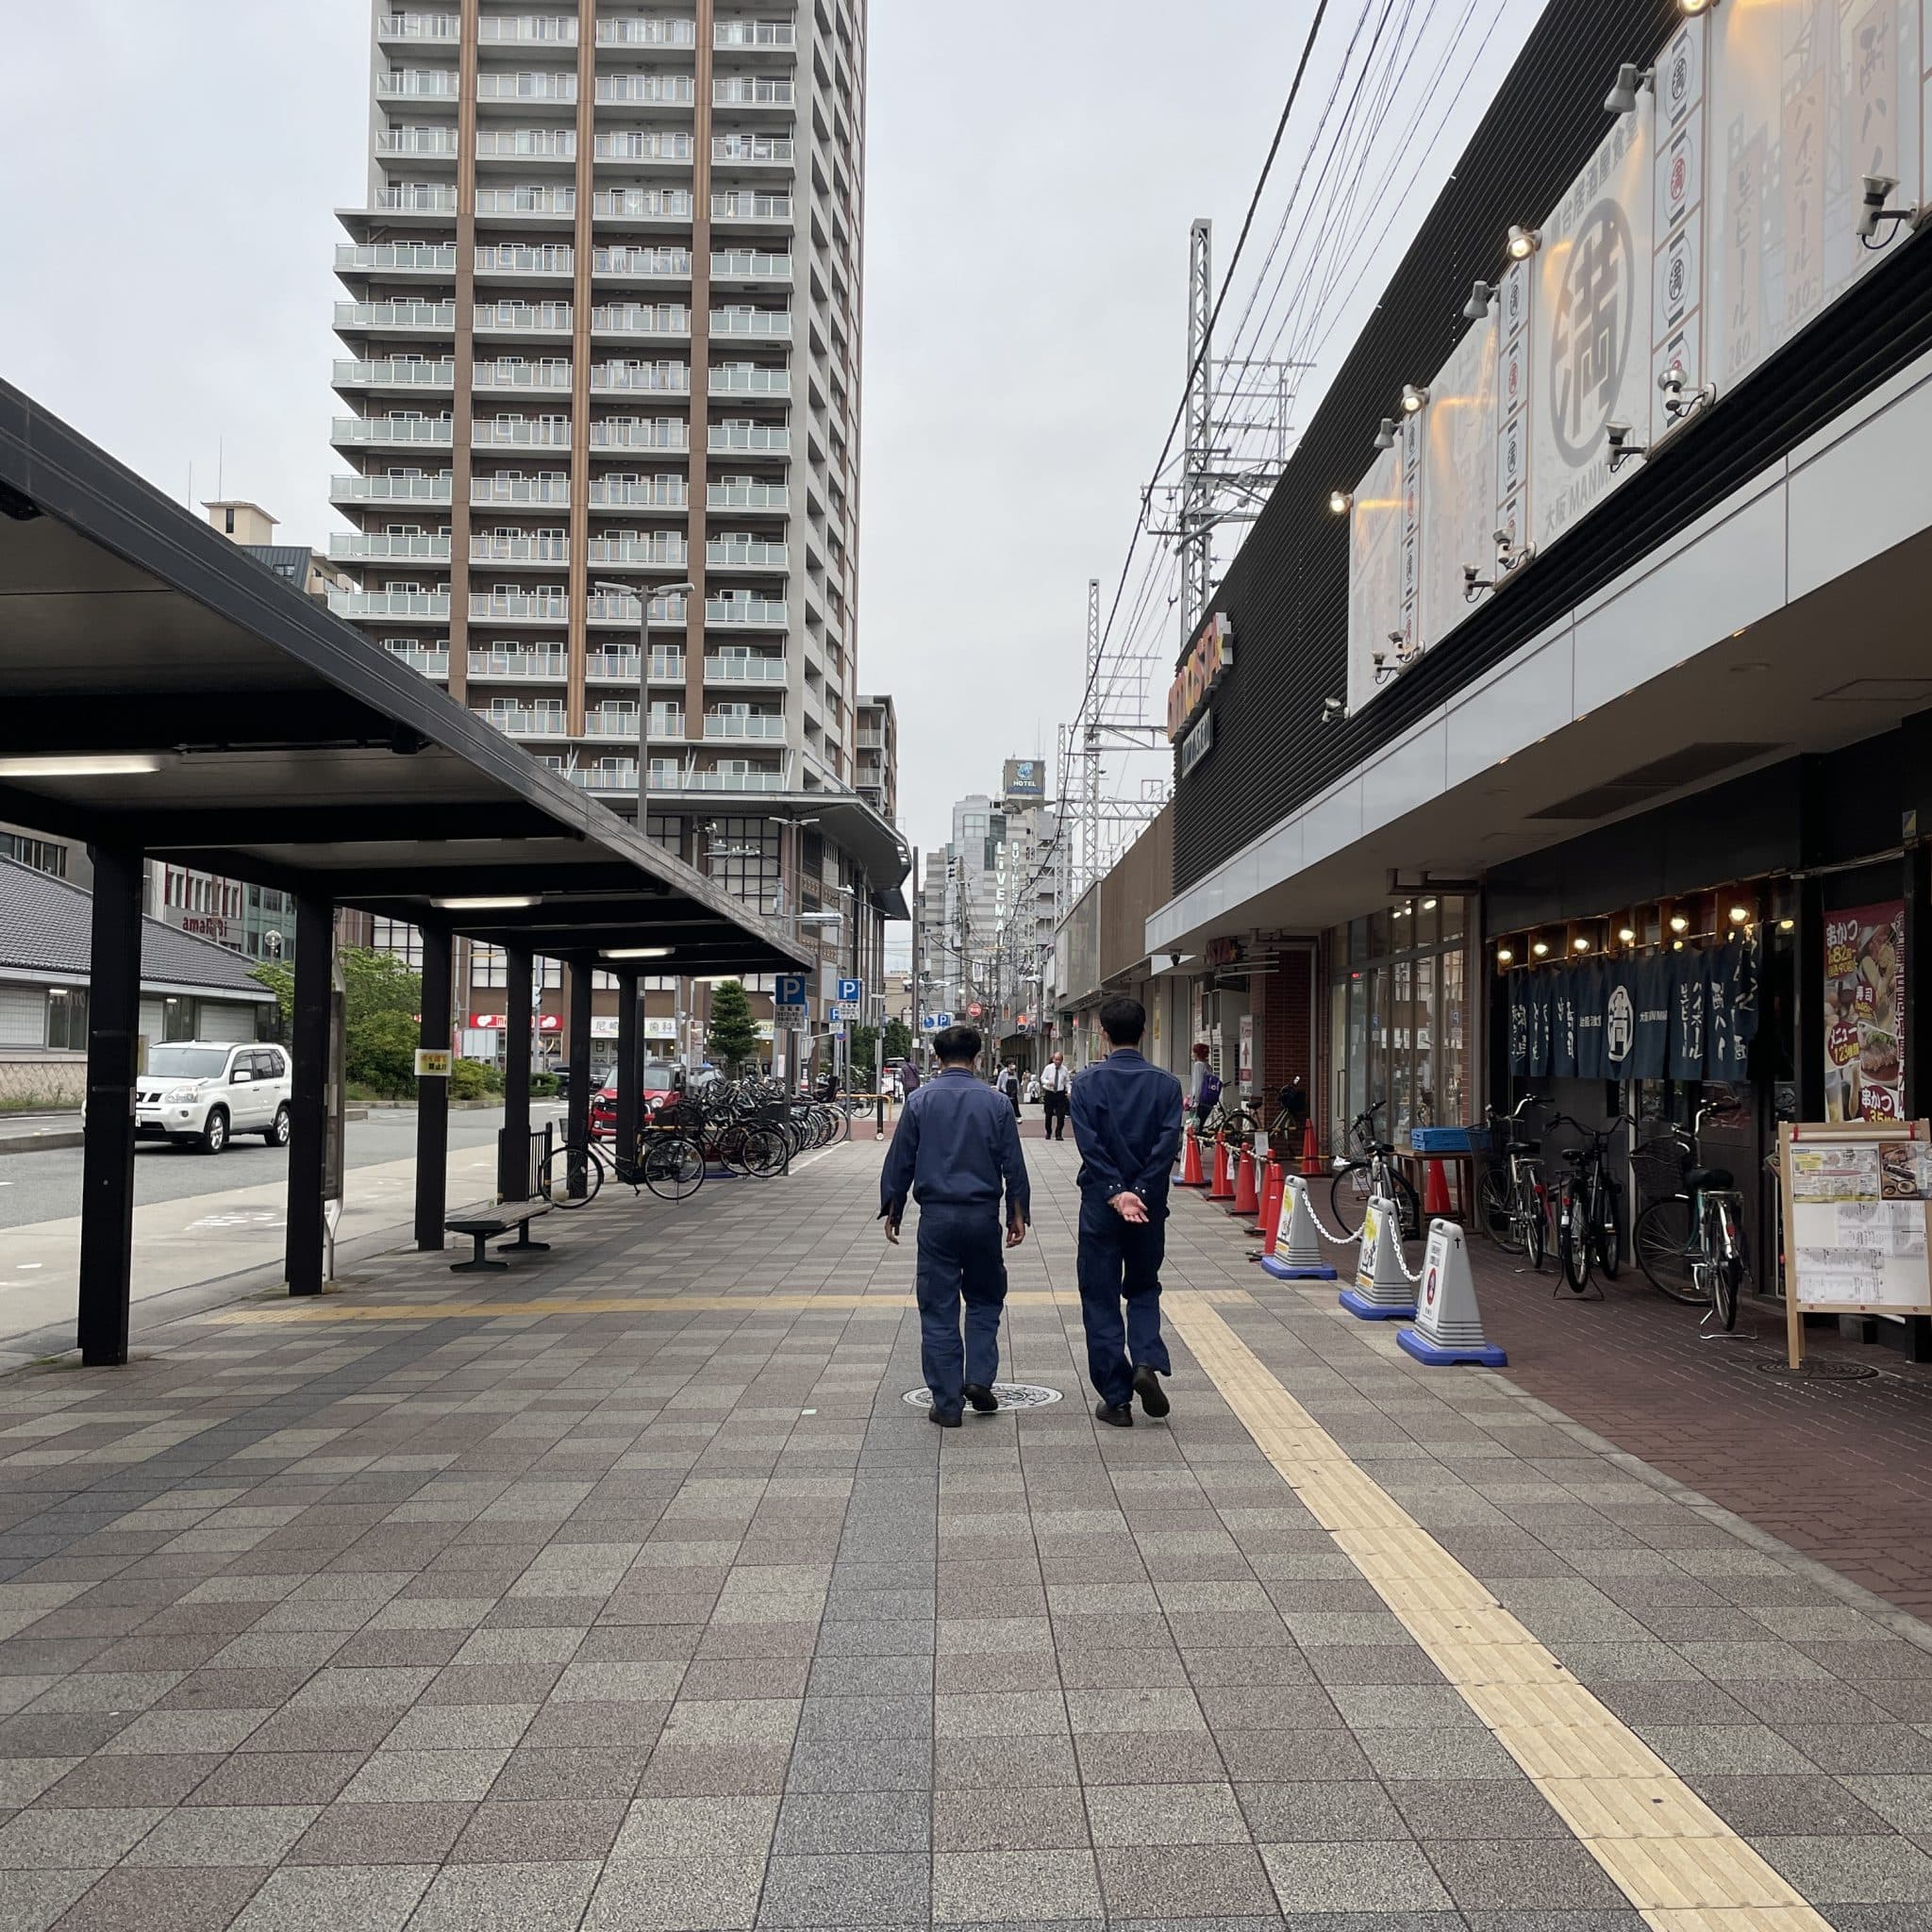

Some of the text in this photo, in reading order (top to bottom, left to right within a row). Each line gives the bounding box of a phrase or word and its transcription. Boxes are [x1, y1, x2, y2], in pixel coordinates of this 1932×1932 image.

[1826, 920, 1857, 947] 串かつ
[782, 977, 801, 1003] P
[842, 981, 856, 999] P
[940, 1014, 949, 1026] P
[1830, 1026, 1857, 1049] メニュー
[1861, 1088, 1892, 1111] 串かつ
